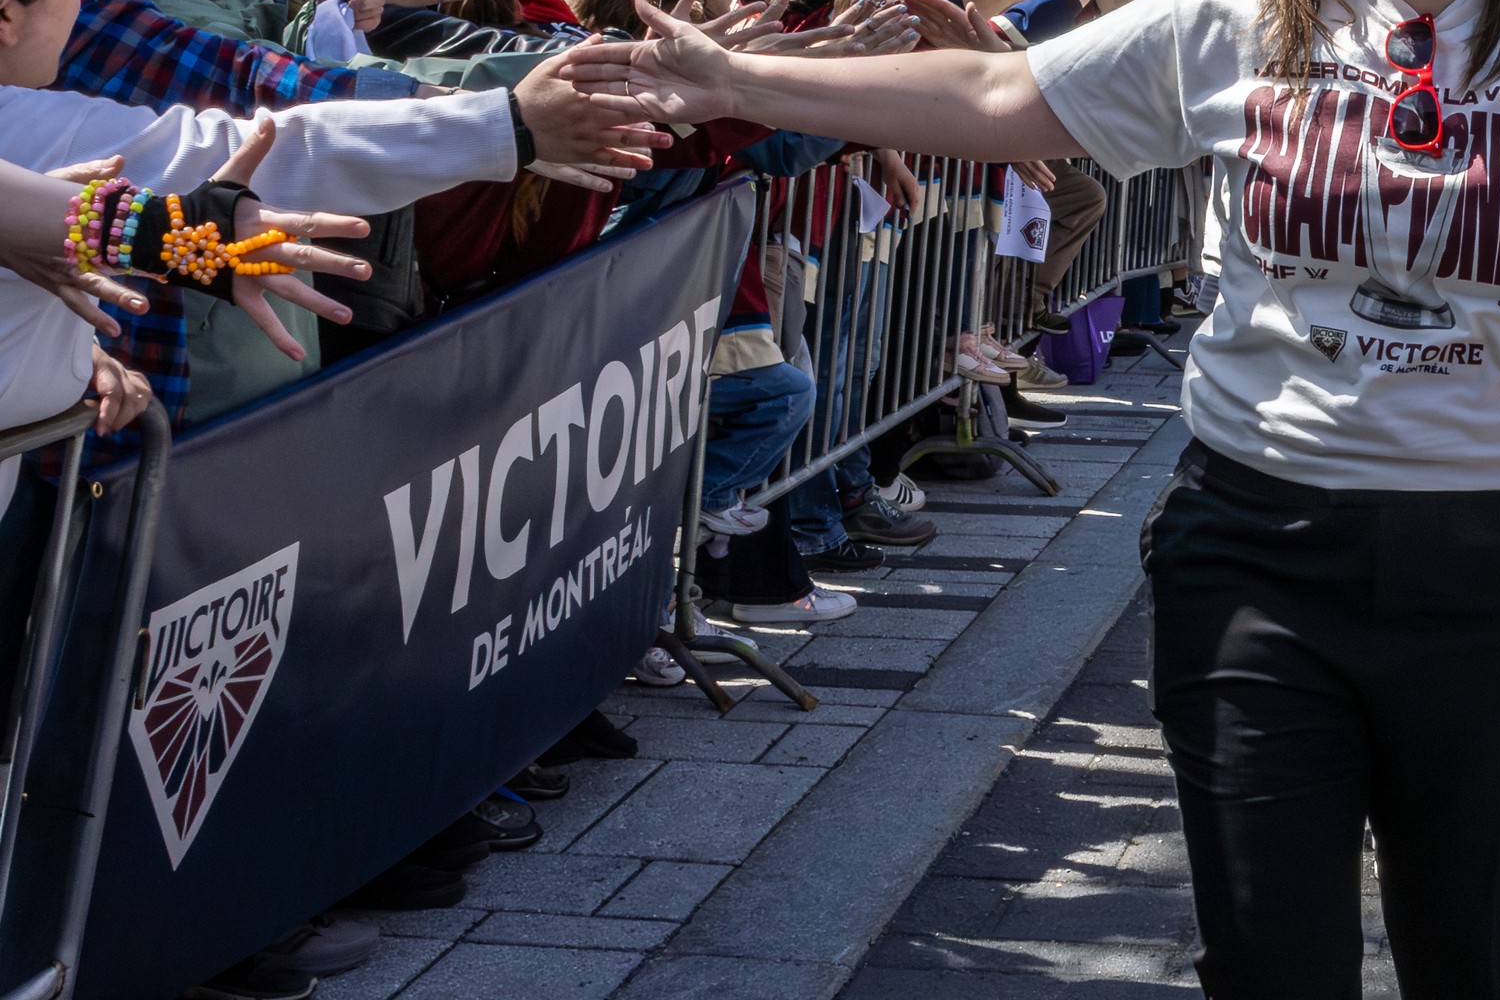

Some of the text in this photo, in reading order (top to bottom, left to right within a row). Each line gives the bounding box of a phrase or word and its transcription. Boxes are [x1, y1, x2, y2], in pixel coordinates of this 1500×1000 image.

[1443, 88, 1478, 106] LA
[1253, 254, 1297, 280] PHF
[1312, 328, 1346, 342] VICTOIRE
[1356, 335, 1484, 366] VICTOIRE
[1380, 361, 1450, 376] DE MONTRÉAL
[384, 294, 722, 645] VICTOIRE
[469, 505, 653, 692] DE MONTRÉAL
[145, 563, 289, 702] VICTOIRE
